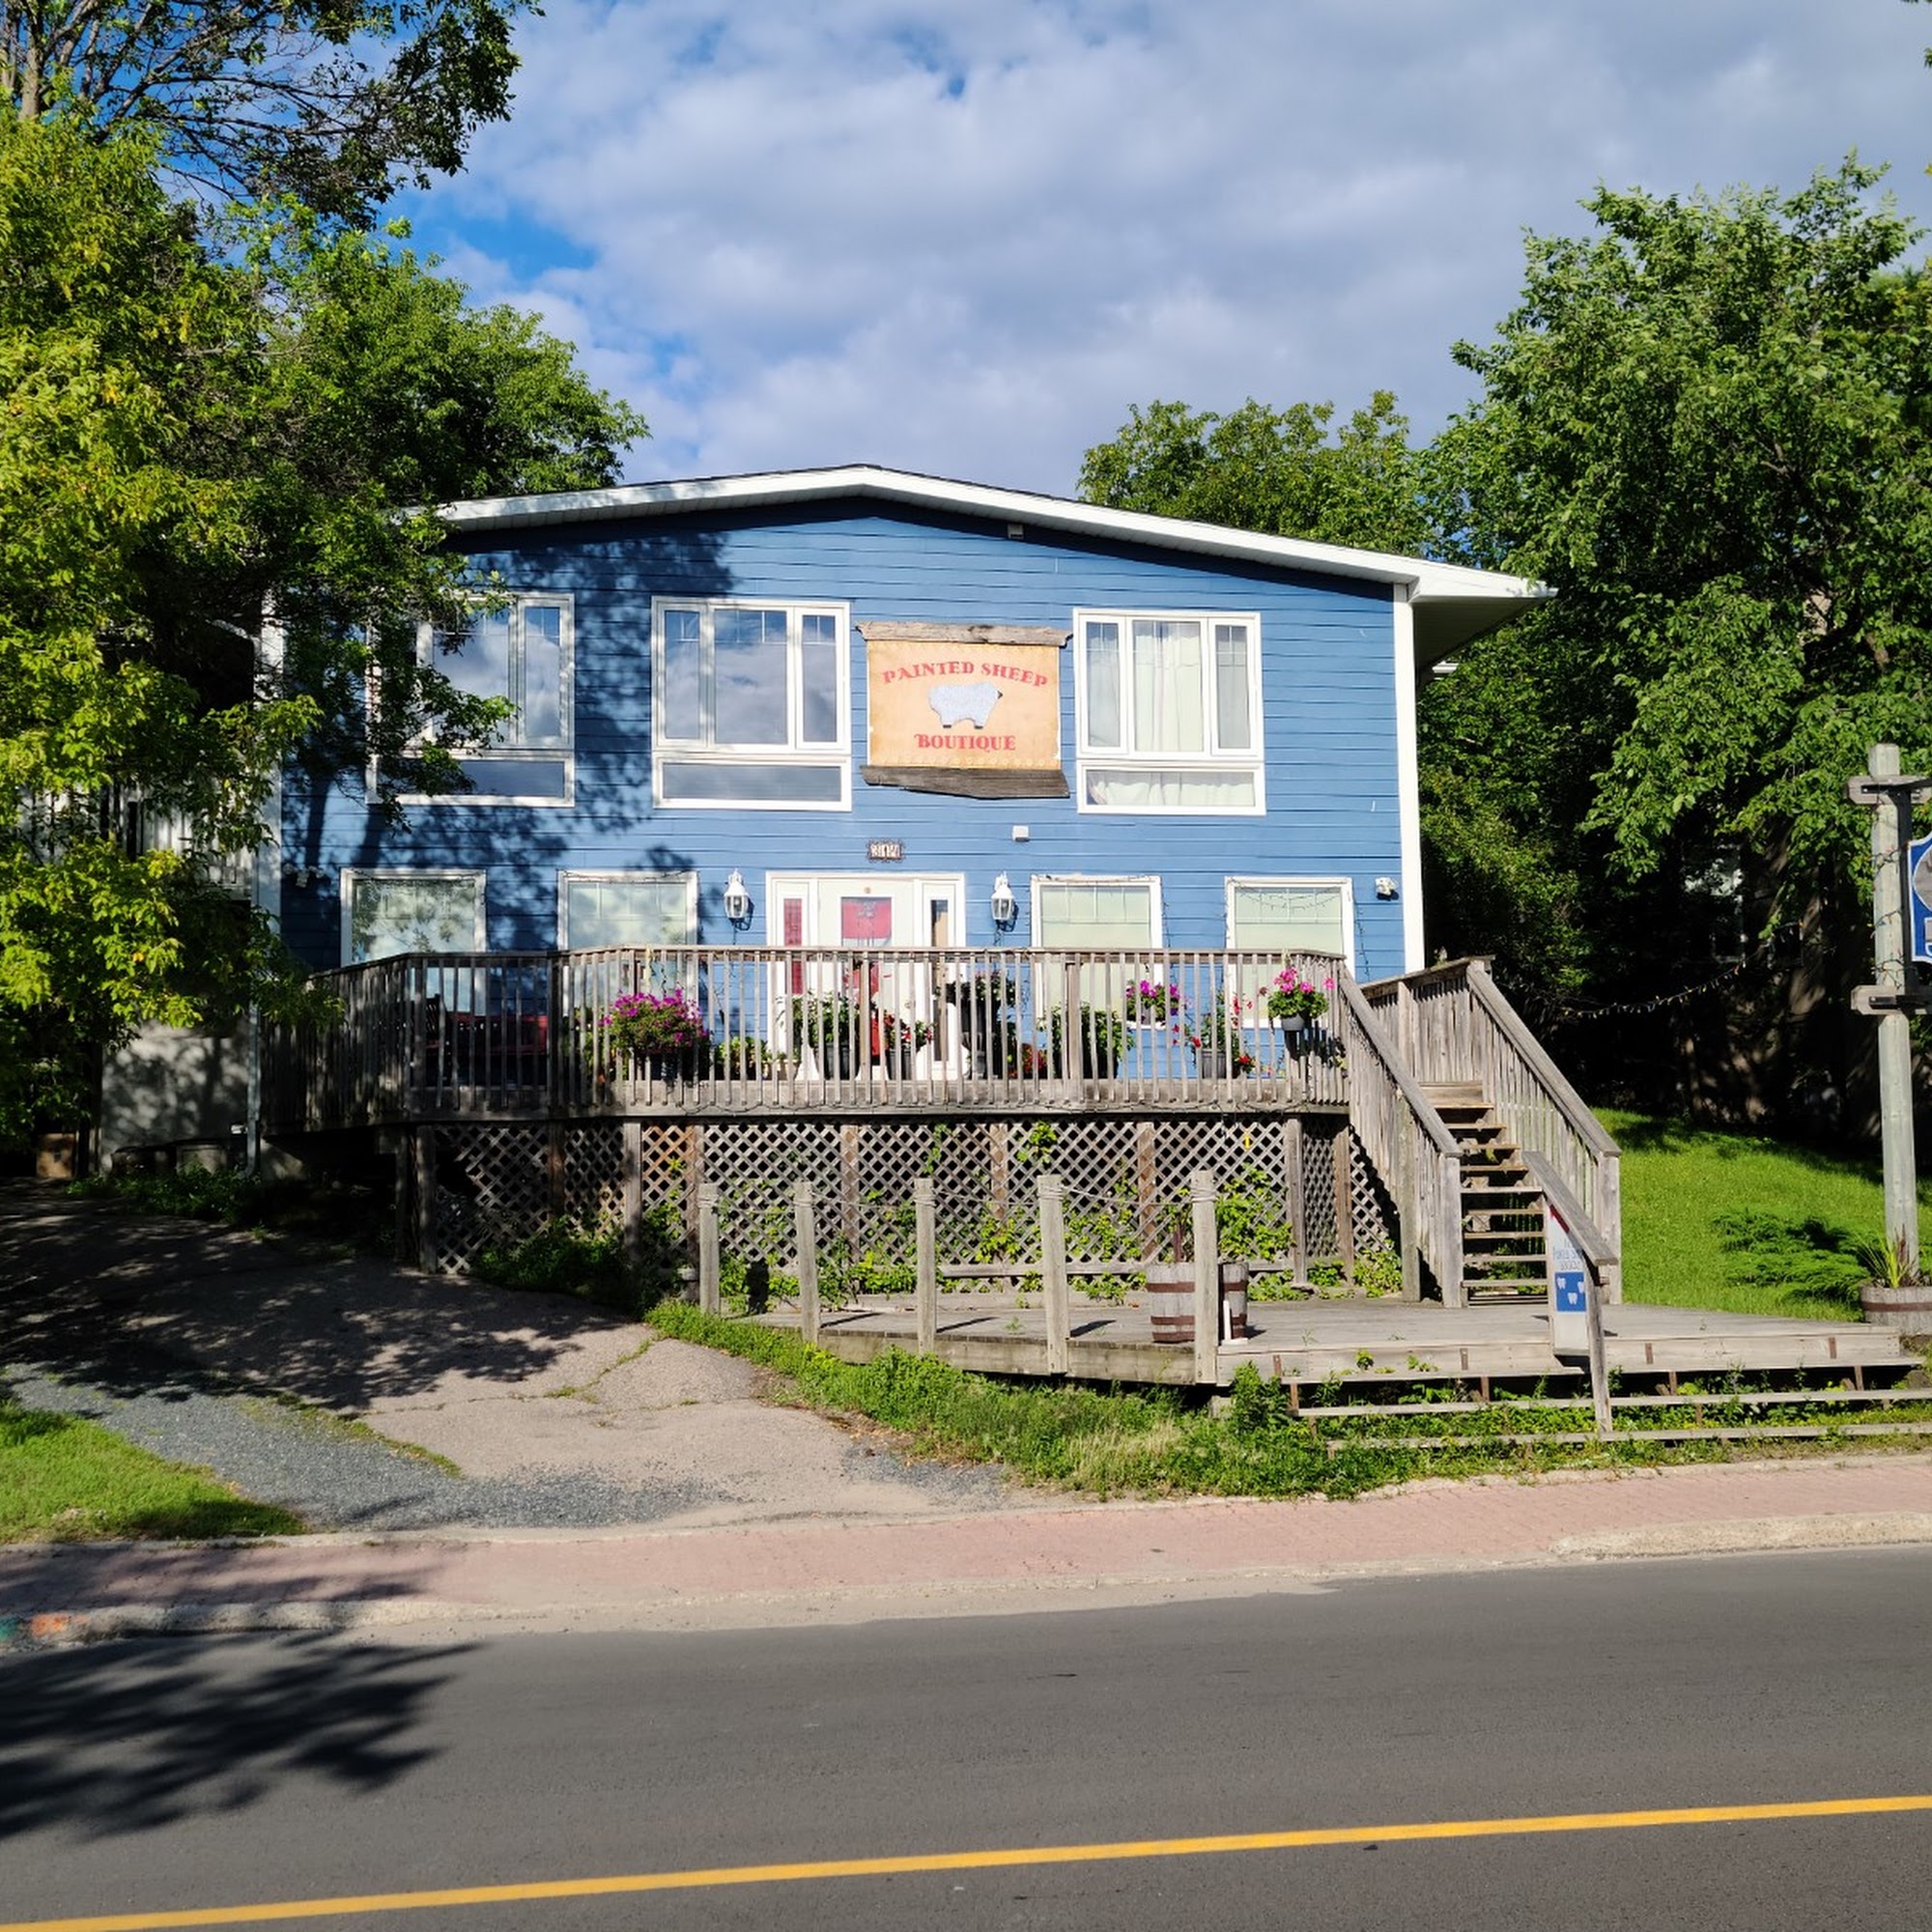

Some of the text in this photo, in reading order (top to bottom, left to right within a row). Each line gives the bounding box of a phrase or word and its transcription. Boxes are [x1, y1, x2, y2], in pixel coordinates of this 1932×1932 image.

[883, 661, 1048, 687] PAINTED SHEEP
[914, 733, 1016, 752] BOUTIQUE
